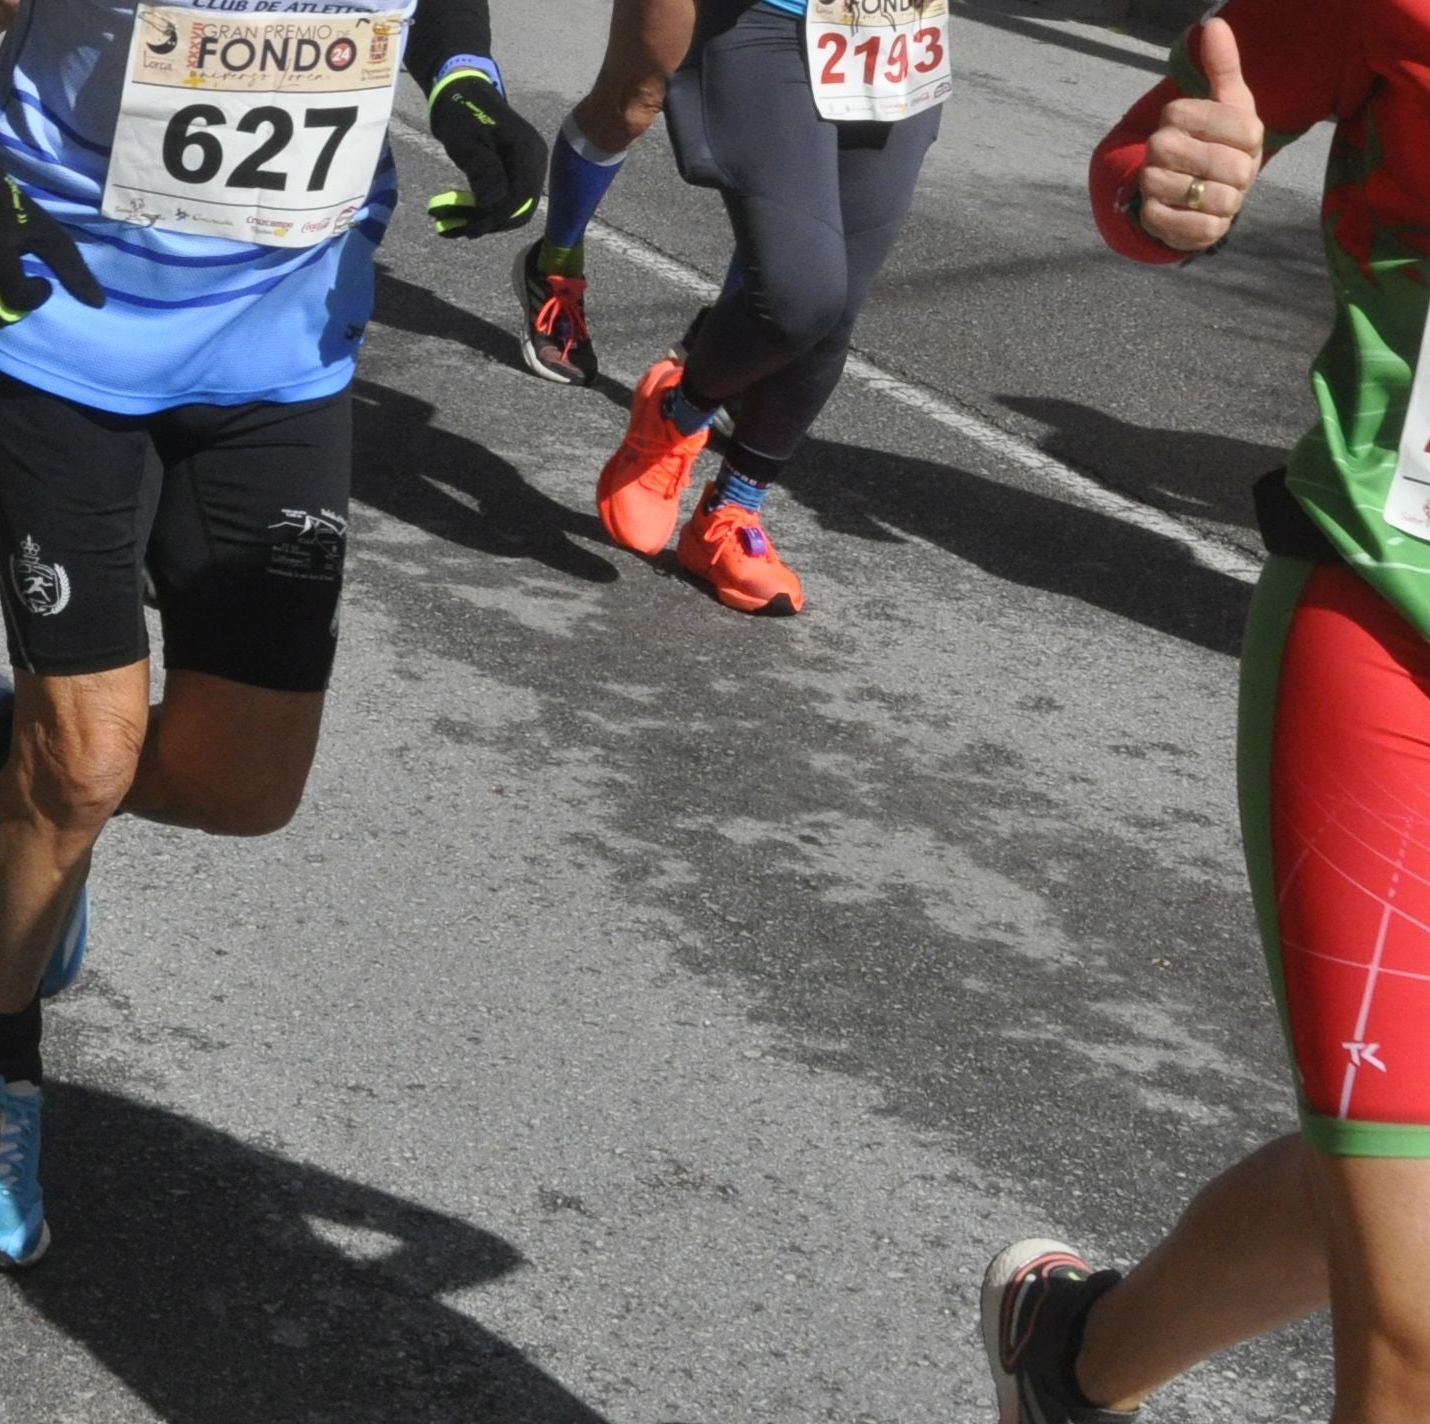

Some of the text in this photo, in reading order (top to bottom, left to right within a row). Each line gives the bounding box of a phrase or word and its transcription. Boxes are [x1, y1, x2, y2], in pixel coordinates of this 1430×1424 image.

[254, 0, 282, 13] DE
[201, 22, 257, 39] GRAN
[262, 23, 332, 40] PREMIO
[196, 36, 358, 73] FONDO
[331, 46, 353, 64] 24
[817, 25, 944, 86] 2193
[162, 102, 359, 193] 627
